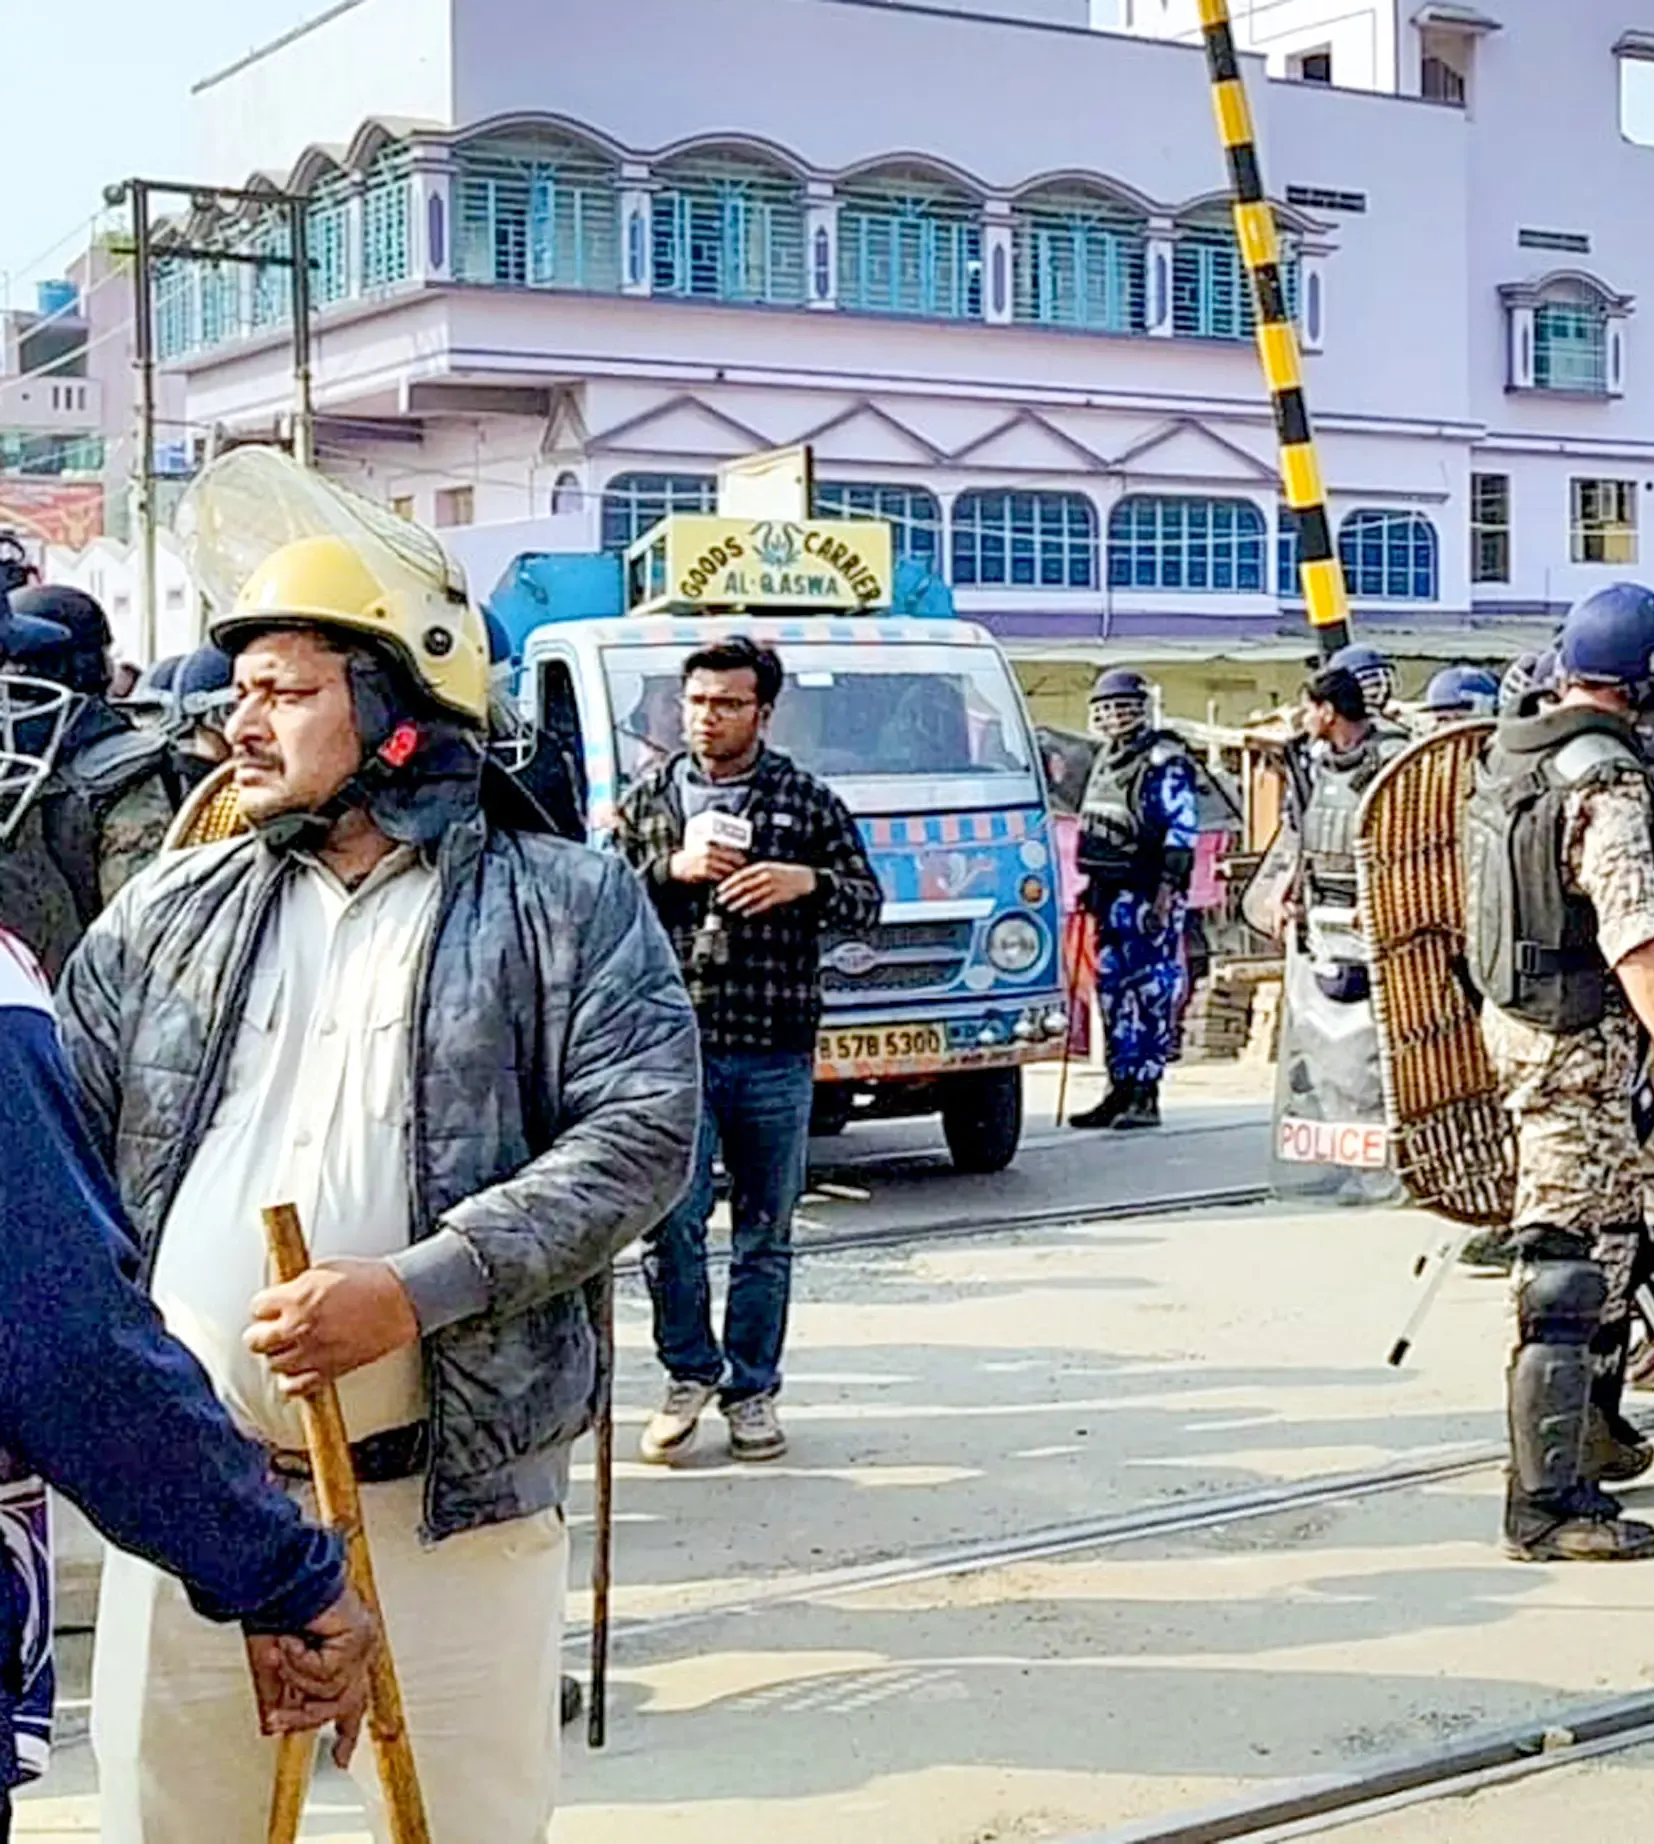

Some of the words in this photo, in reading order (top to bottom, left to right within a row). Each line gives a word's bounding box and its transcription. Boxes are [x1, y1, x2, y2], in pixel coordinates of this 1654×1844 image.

[680, 536, 745, 599] GOODS
[804, 531, 882, 600] CARRIER
[885, 1030, 939, 1056] 5300
[1281, 1122, 1382, 1162] POLICE
